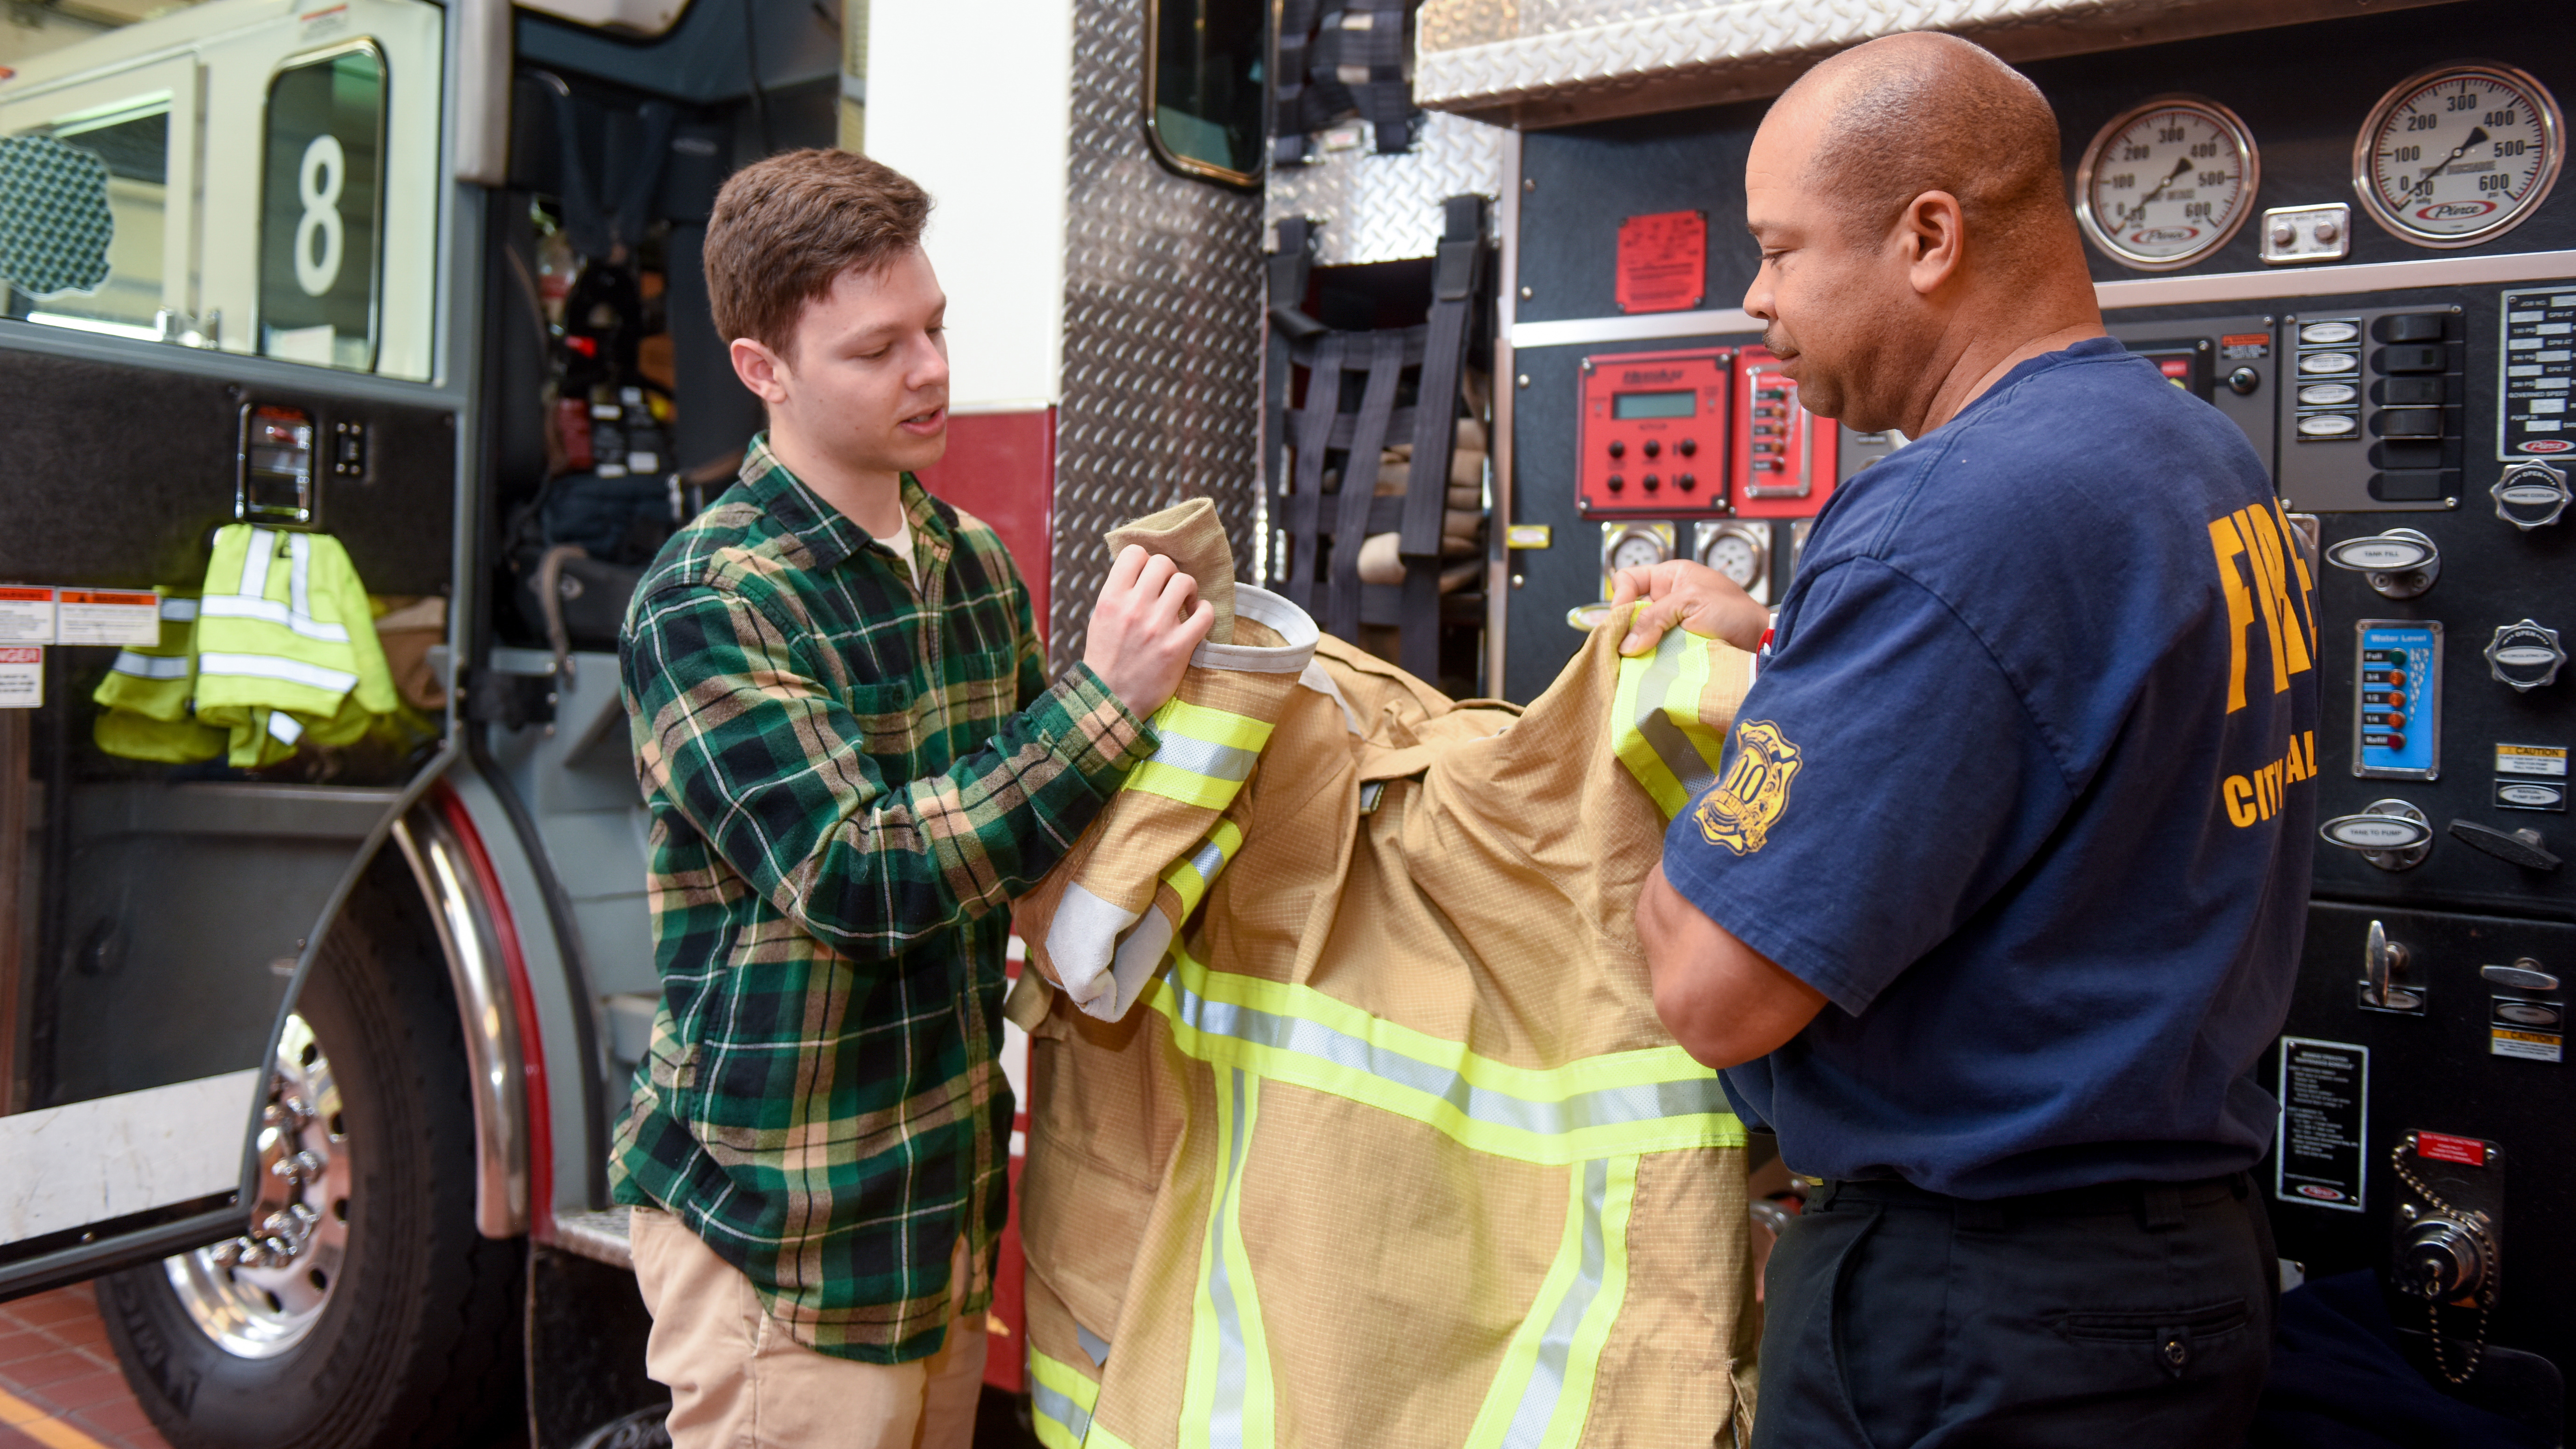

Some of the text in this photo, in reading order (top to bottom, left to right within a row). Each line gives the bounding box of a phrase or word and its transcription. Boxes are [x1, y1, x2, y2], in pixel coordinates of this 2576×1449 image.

[2447, 94, 2477, 112] 300
[2408, 114, 2437, 131] 200
[2484, 110, 2514, 127] 400
[2158, 126, 2185, 143] 300
[2124, 145, 2149, 161] 200
[2191, 143, 2217, 157] 400
[2394, 146, 2420, 162] 100
[2494, 140, 2525, 157] 500
[2113, 173, 2135, 189] 100
[2199, 170, 2225, 186] 500
[2400, 176, 2408, 191] 0
[2479, 174, 2510, 191] 600
[295, 135, 345, 297] 8
[2185, 201, 2212, 217] 600
[2435, 205, 2481, 218] Pierce
[2370, 634, 2427, 643] Water Level
[2516, 747, 2558, 756] CAUTION
[2223, 758, 2283, 828] CITY
